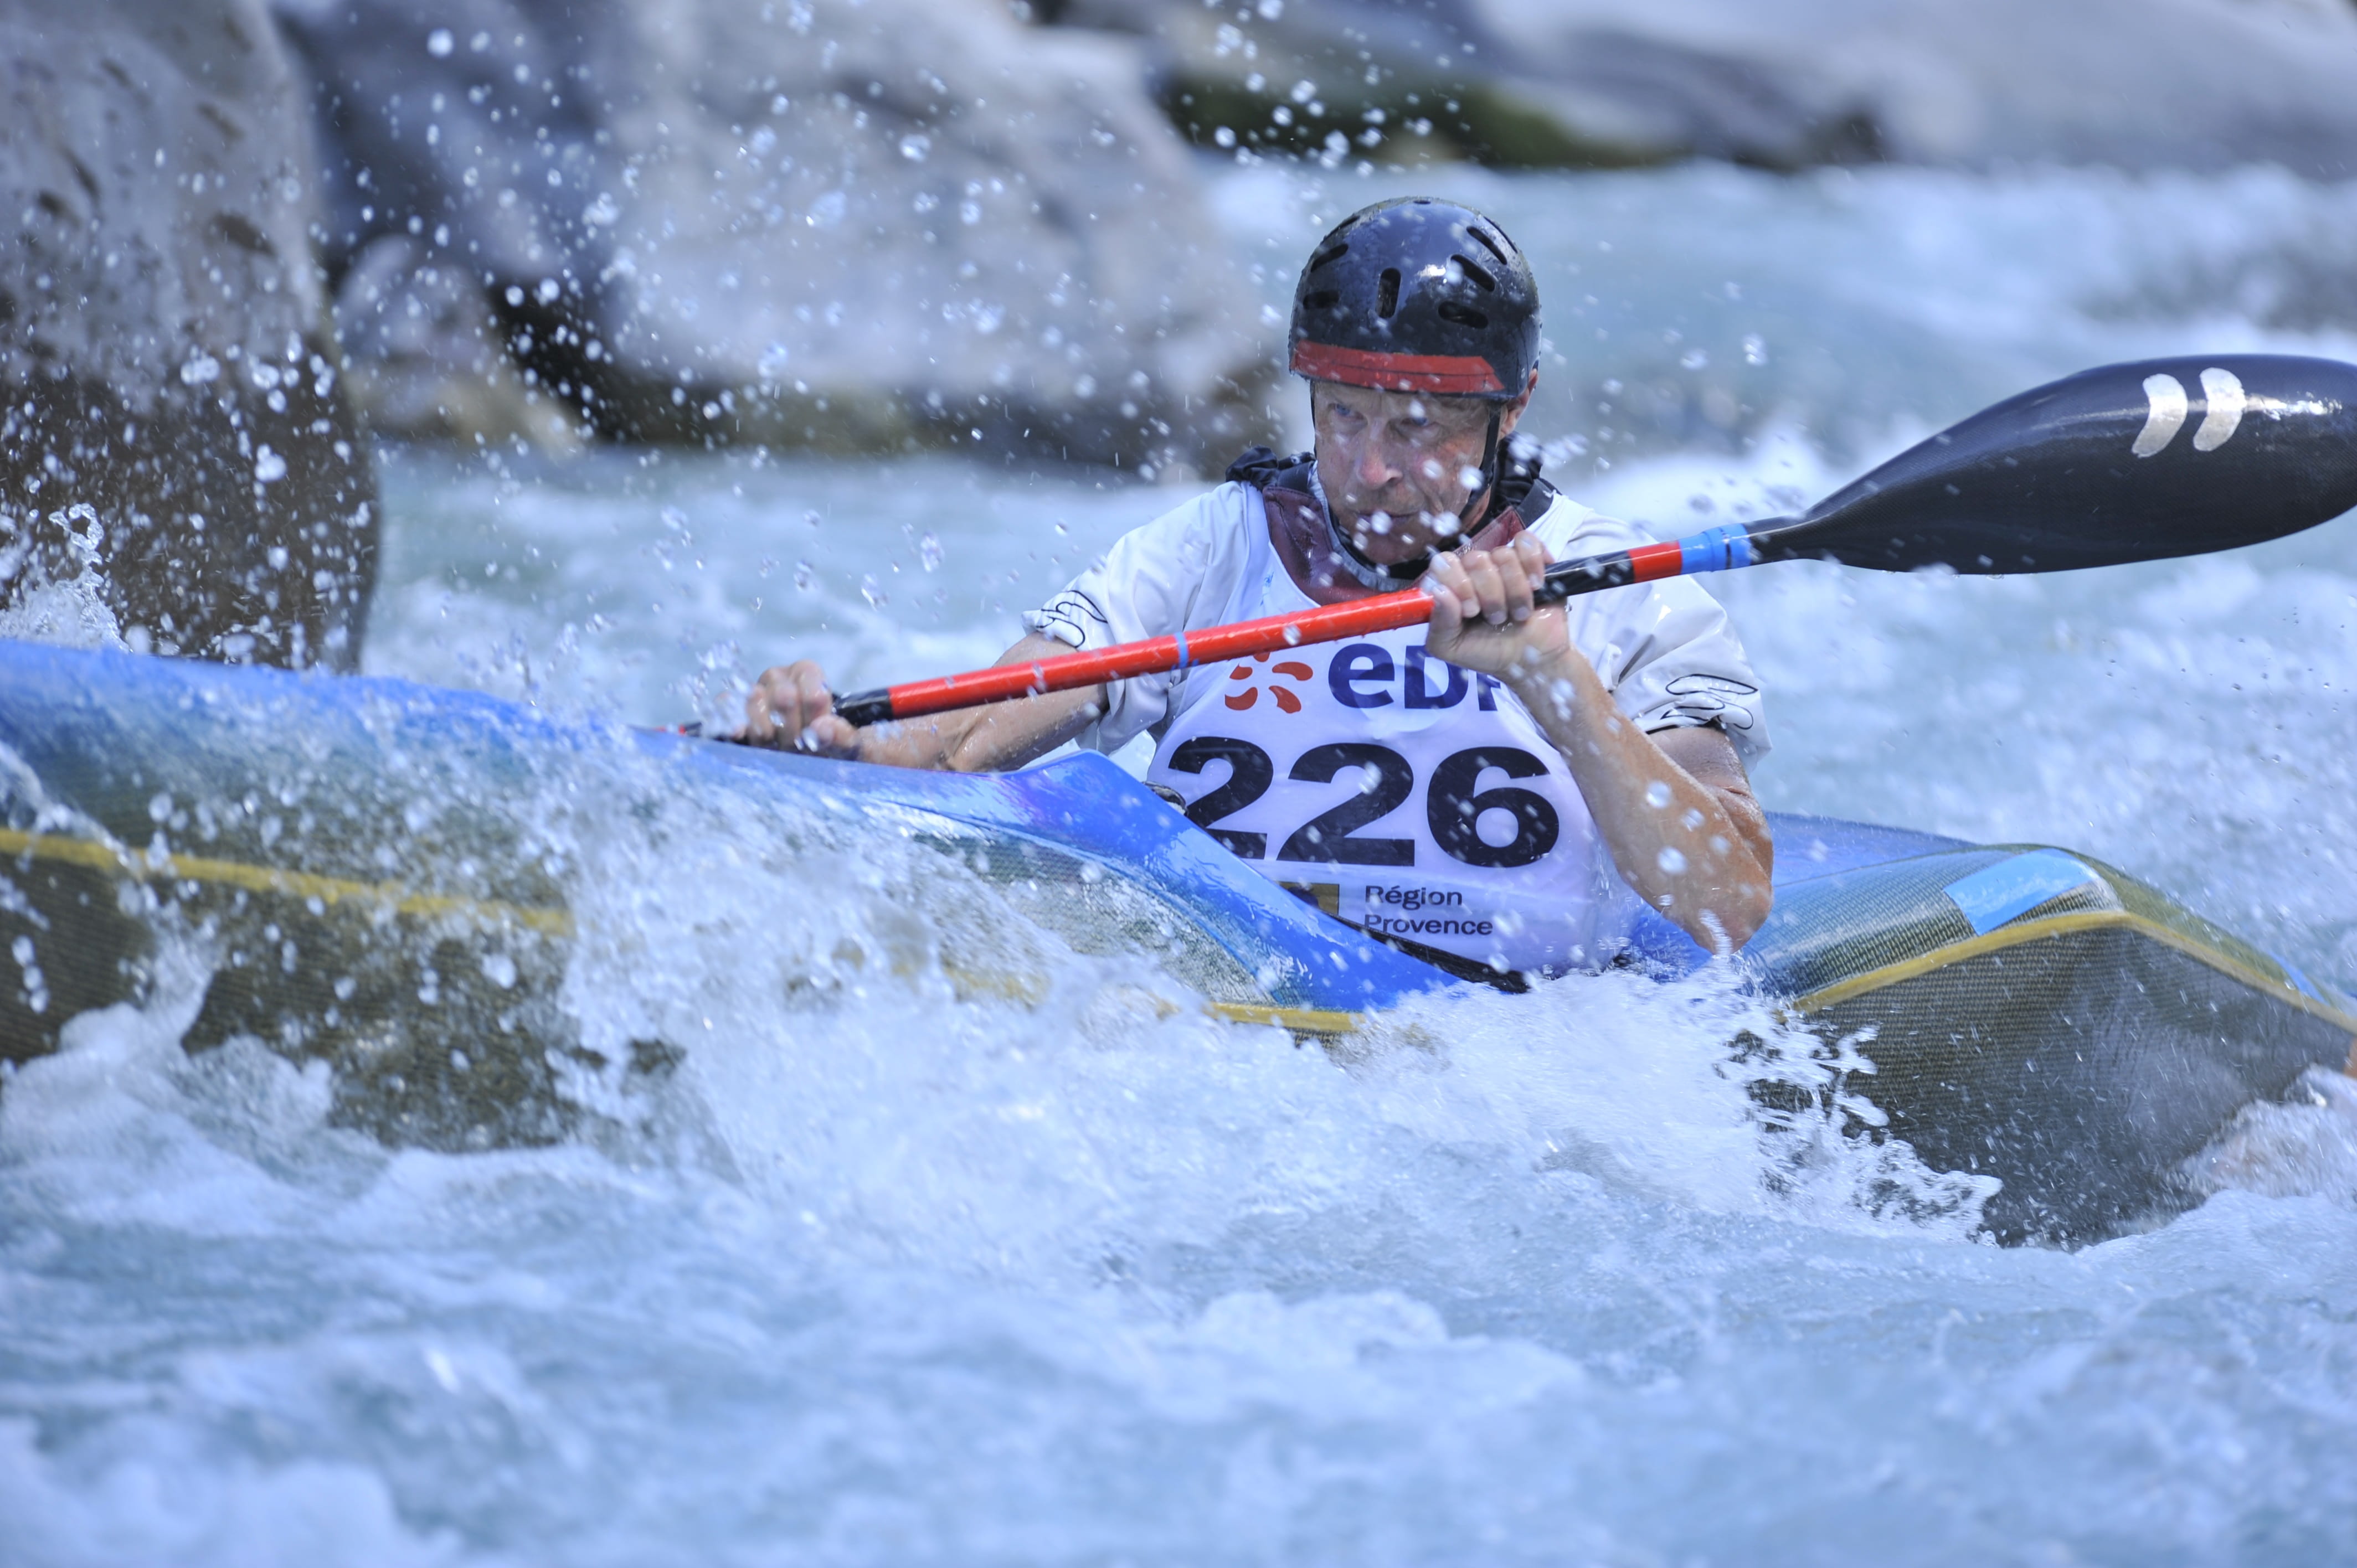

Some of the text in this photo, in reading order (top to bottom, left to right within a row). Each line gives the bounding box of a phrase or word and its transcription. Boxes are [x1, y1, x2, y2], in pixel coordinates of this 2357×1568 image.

[1168, 736, 1560, 868] 226
[1365, 885, 1463, 910] Région
[1364, 914, 1493, 935] Provence
